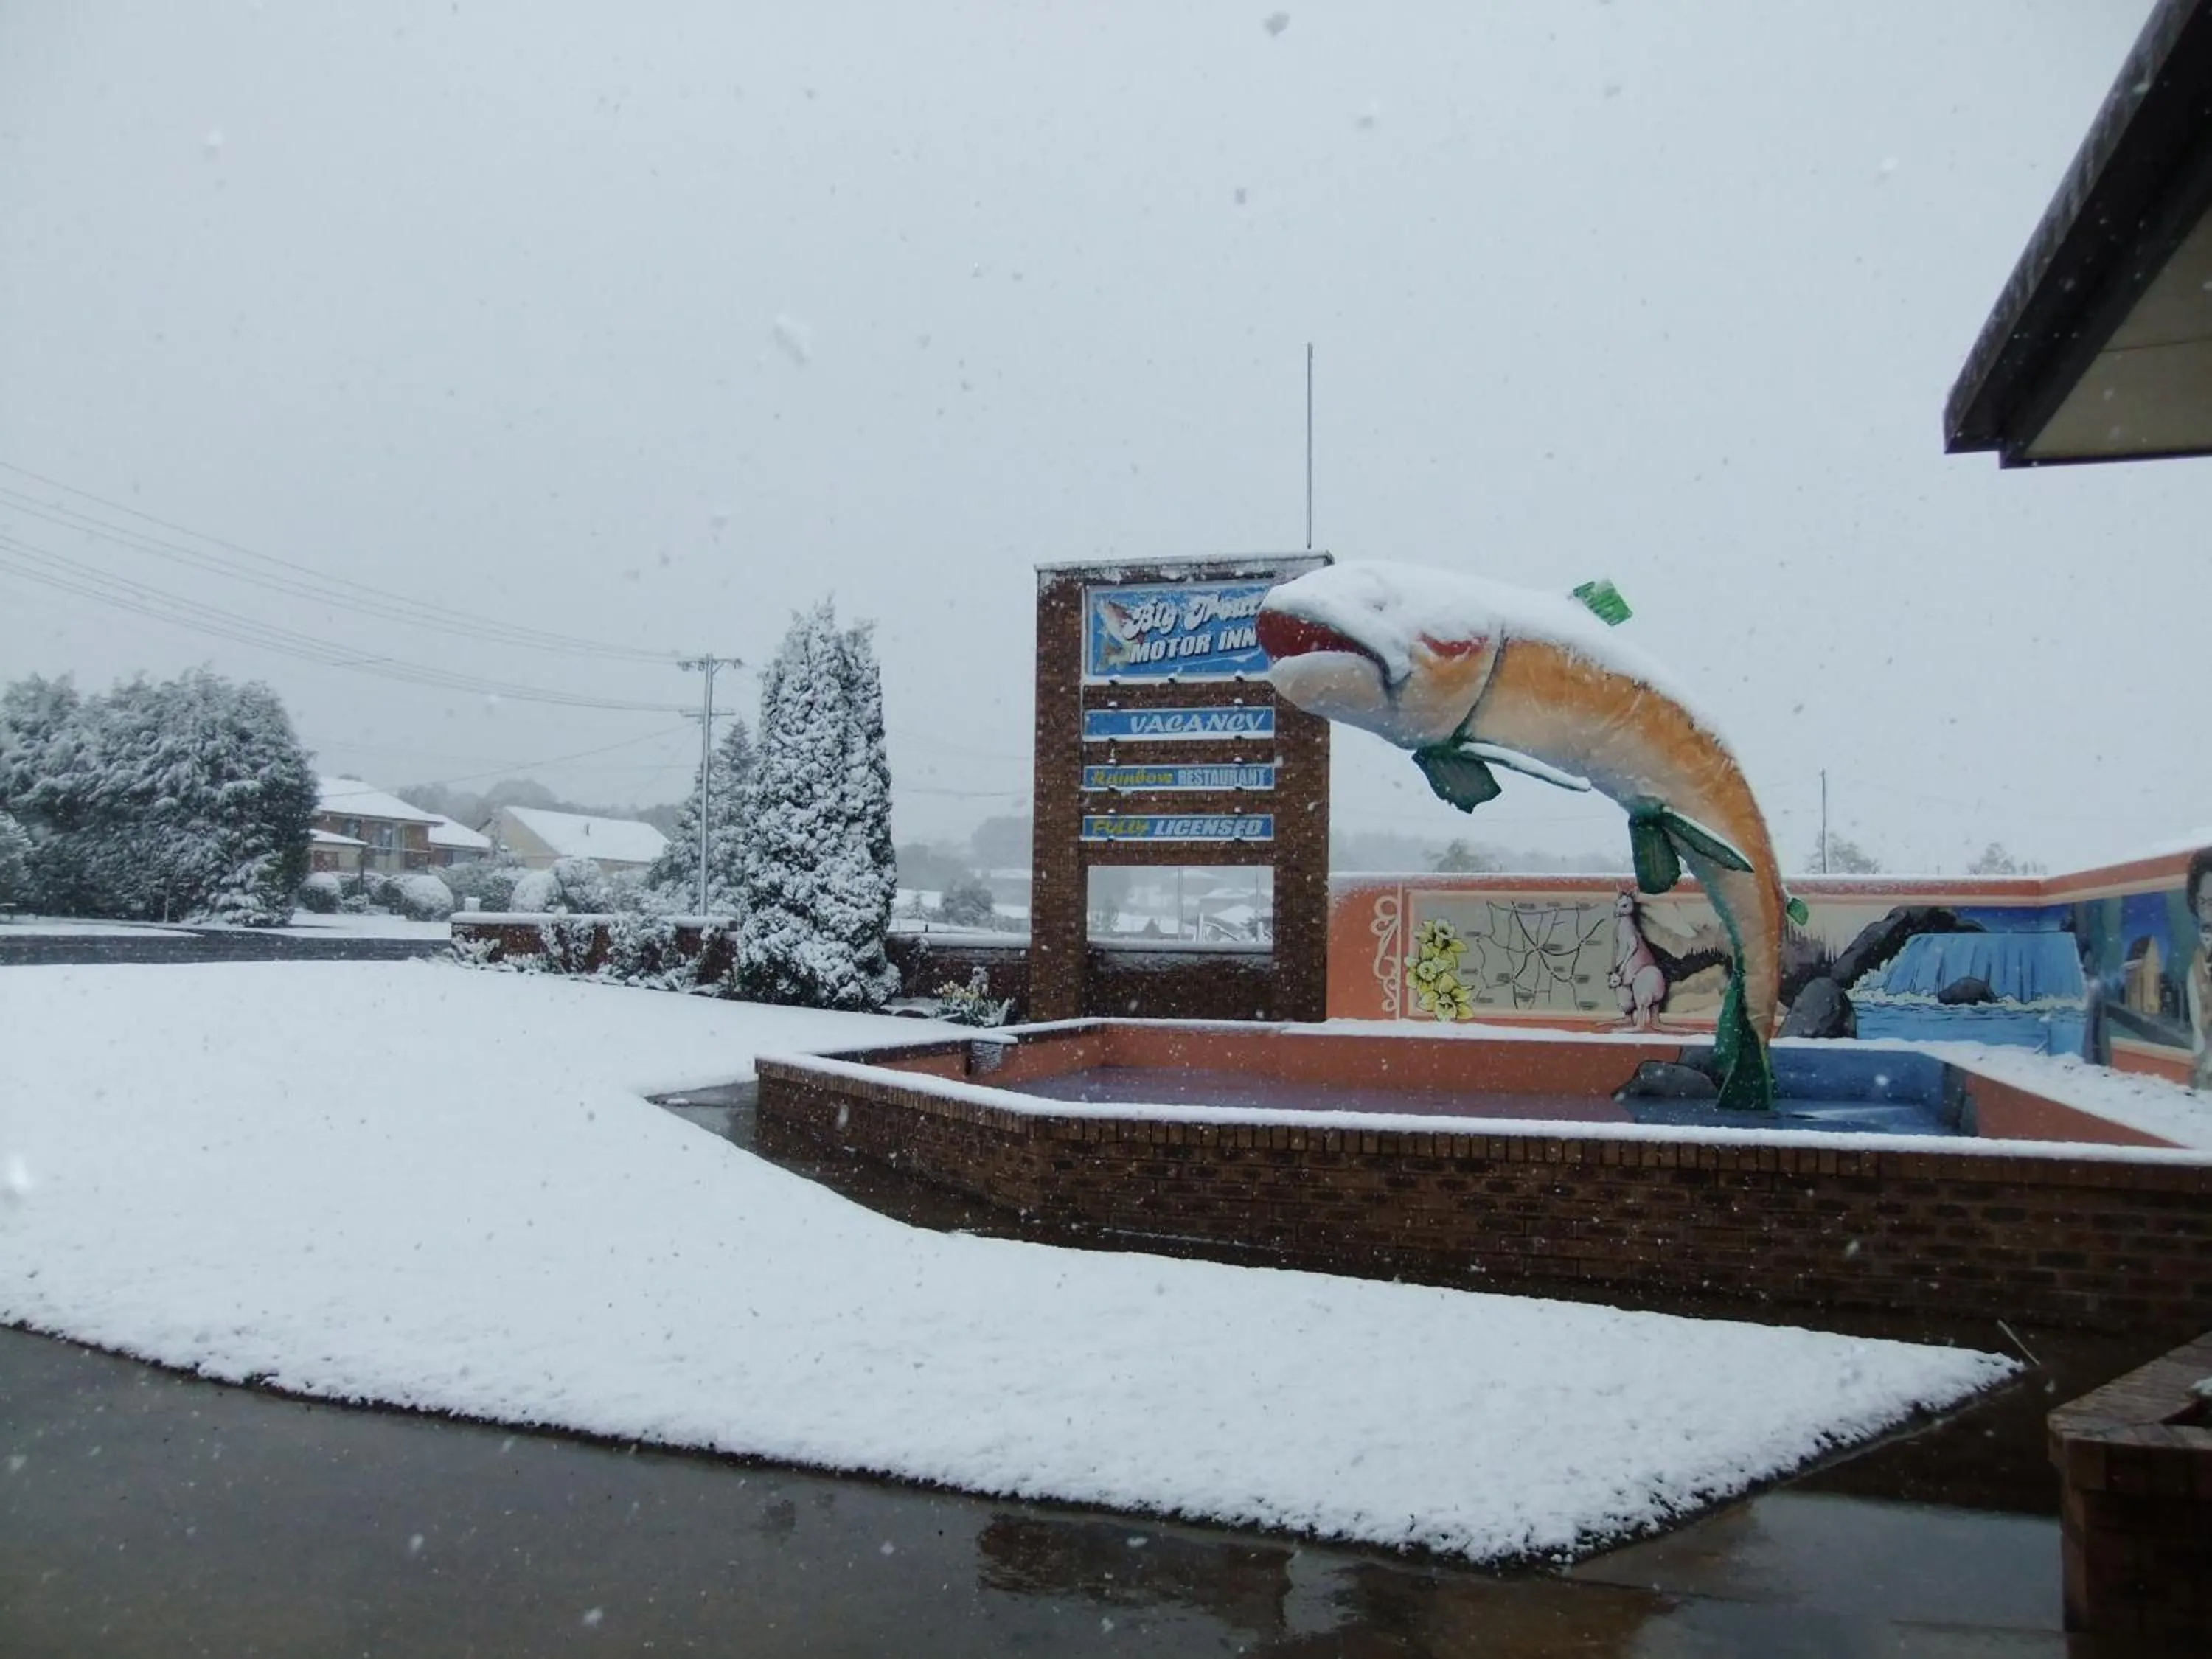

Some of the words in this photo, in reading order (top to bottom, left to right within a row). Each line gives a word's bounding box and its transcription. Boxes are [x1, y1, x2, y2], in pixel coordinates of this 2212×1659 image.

[1122, 596, 1178, 640] Big
[1129, 633, 1211, 663] MOTOR
[1218, 627, 1258, 651] INN
[1130, 709, 1267, 733] VACANCY
[1178, 768, 1265, 787] RESTAURANT
[1154, 819, 1263, 836] LICENSED
